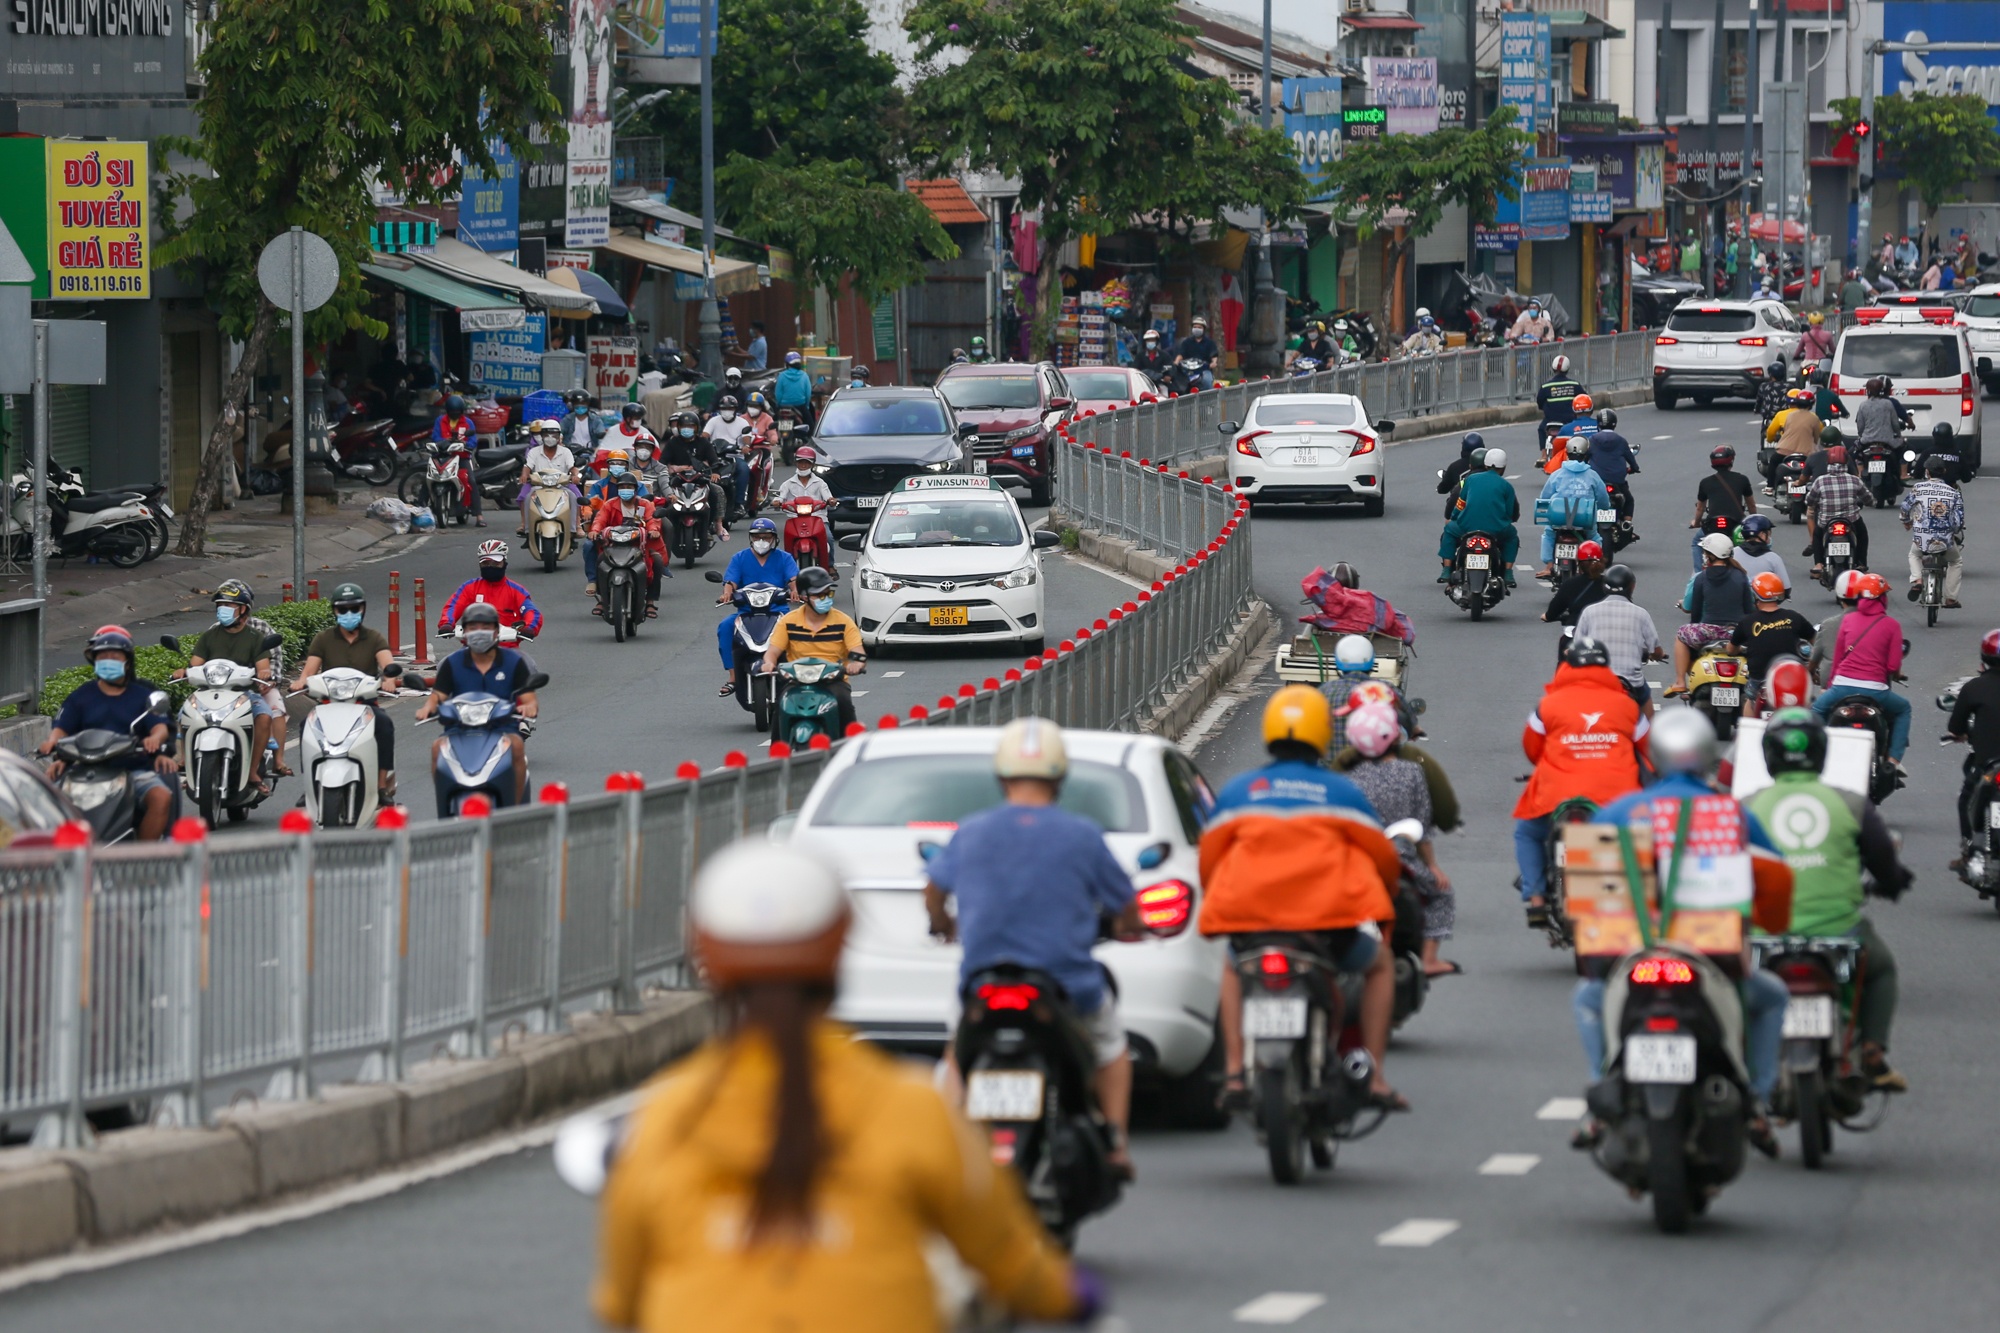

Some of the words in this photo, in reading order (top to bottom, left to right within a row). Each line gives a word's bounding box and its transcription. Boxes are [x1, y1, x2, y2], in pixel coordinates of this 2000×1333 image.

[1504, 39, 1532, 55] COPY
[1344, 110, 1364, 122] LINH
[1351, 124, 1379, 136] STORE
[64, 151, 100, 187] ĐỒ
[106, 159, 132, 187] SI
[58, 189, 140, 228] TUYỂN
[58, 235, 102, 268] GIÁ
[108, 232, 141, 268] RẺ
[59, 275, 142, 292] 0918.119.616
[485, 364, 508, 380] Rửa
[1298, 447, 1312, 456] 61A
[1293, 456, 1317, 464] 478.85
[940, 607, 957, 616] 51F
[933, 616, 964, 625] 998.67
[1561, 733, 1618, 745] LALAMOVE
